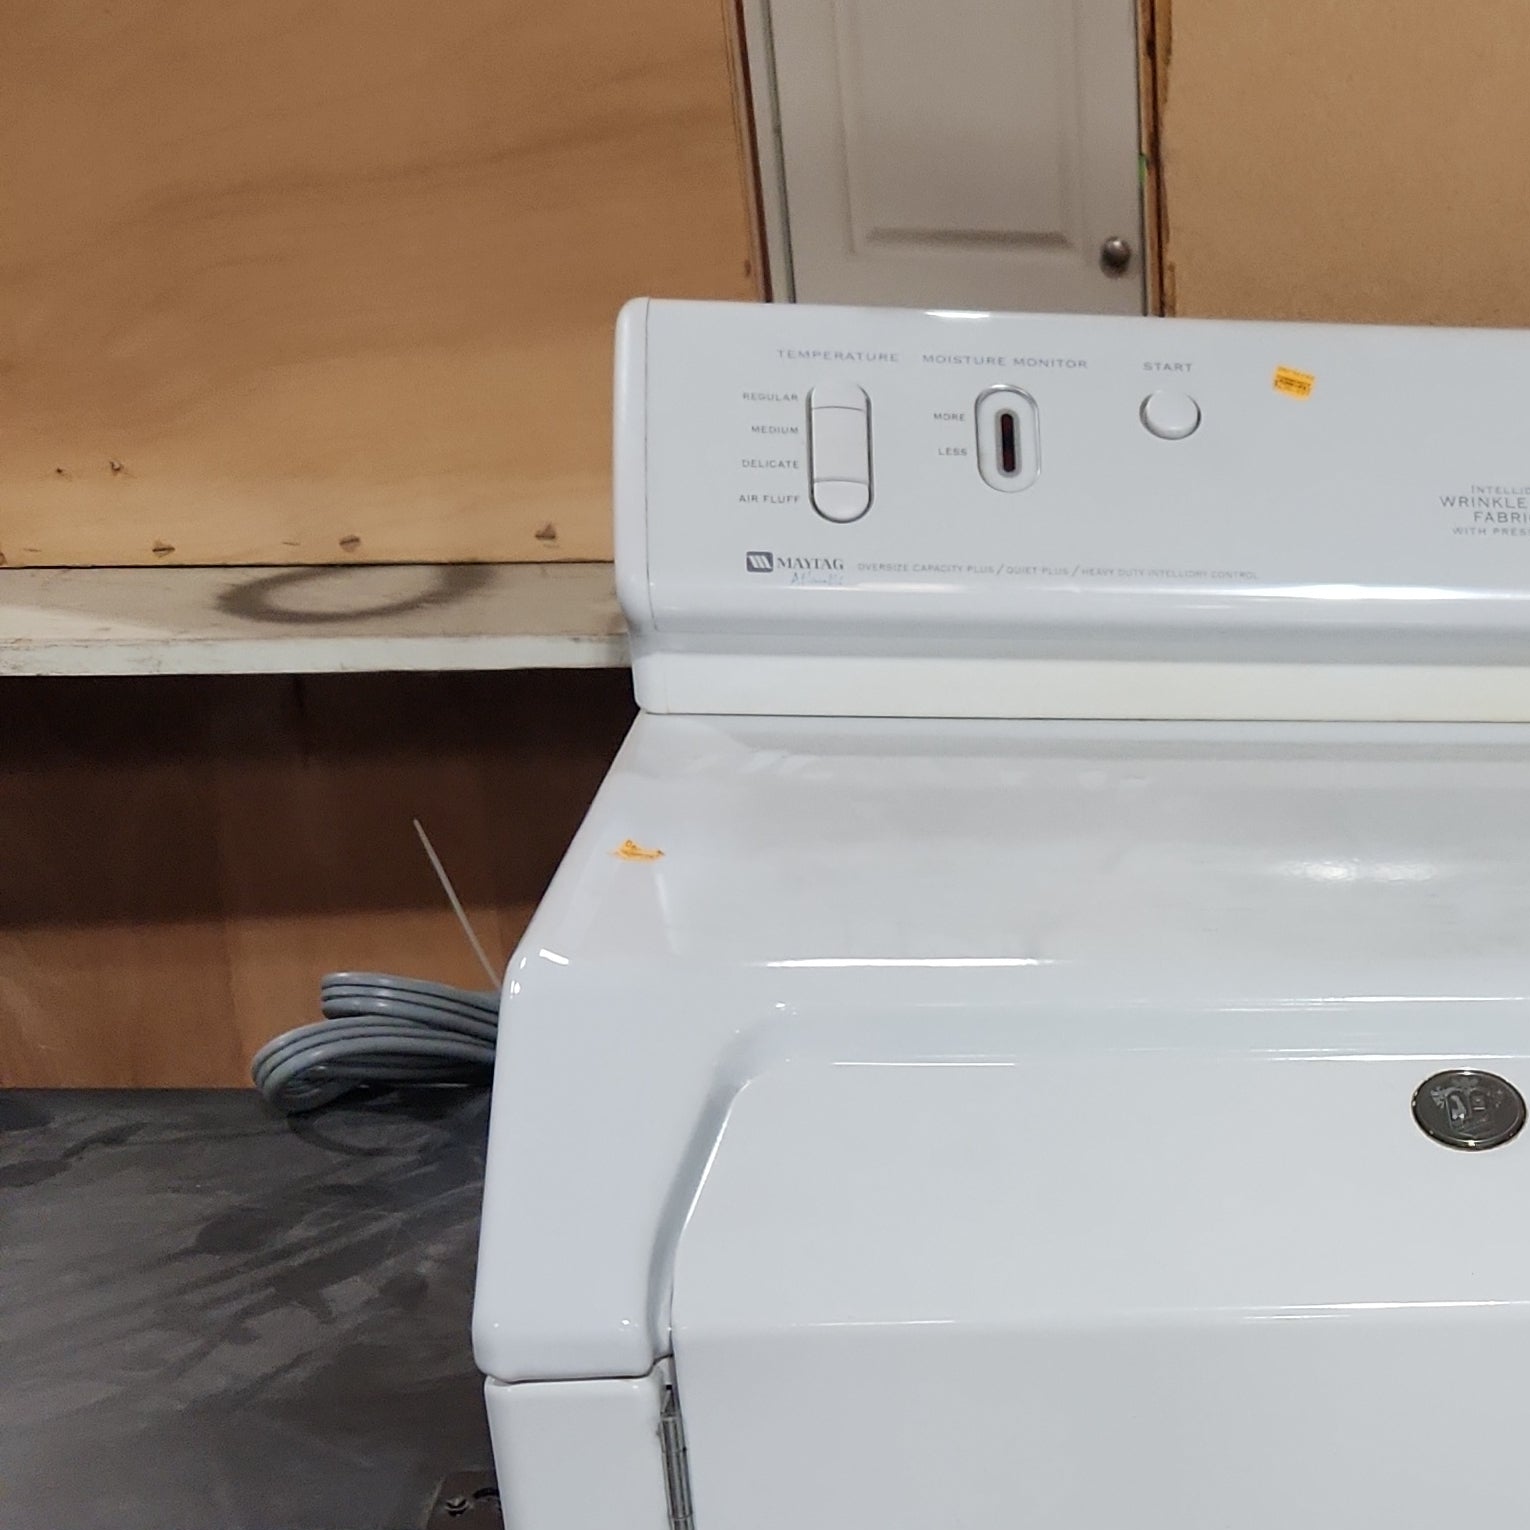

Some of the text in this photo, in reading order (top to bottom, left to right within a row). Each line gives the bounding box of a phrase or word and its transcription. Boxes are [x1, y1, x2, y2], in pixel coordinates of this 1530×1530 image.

[777, 349, 898, 363] TEMPERATURE
[922, 354, 1088, 369] MOISTURE MONITOR
[1143, 362, 1193, 372] START
[742, 392, 799, 402] REGULAR
[933, 412, 966, 422] MORE
[751, 425, 799, 435] MEDIUM
[937, 447, 968, 457] LESS
[741, 459, 799, 469] DELICATE
[738, 494, 801, 504] AIR FLUFF
[1440, 496, 1528, 509] WRINKLE
[1452, 527, 1487, 536] WITH
[777, 556, 844, 571] MAYTAG
